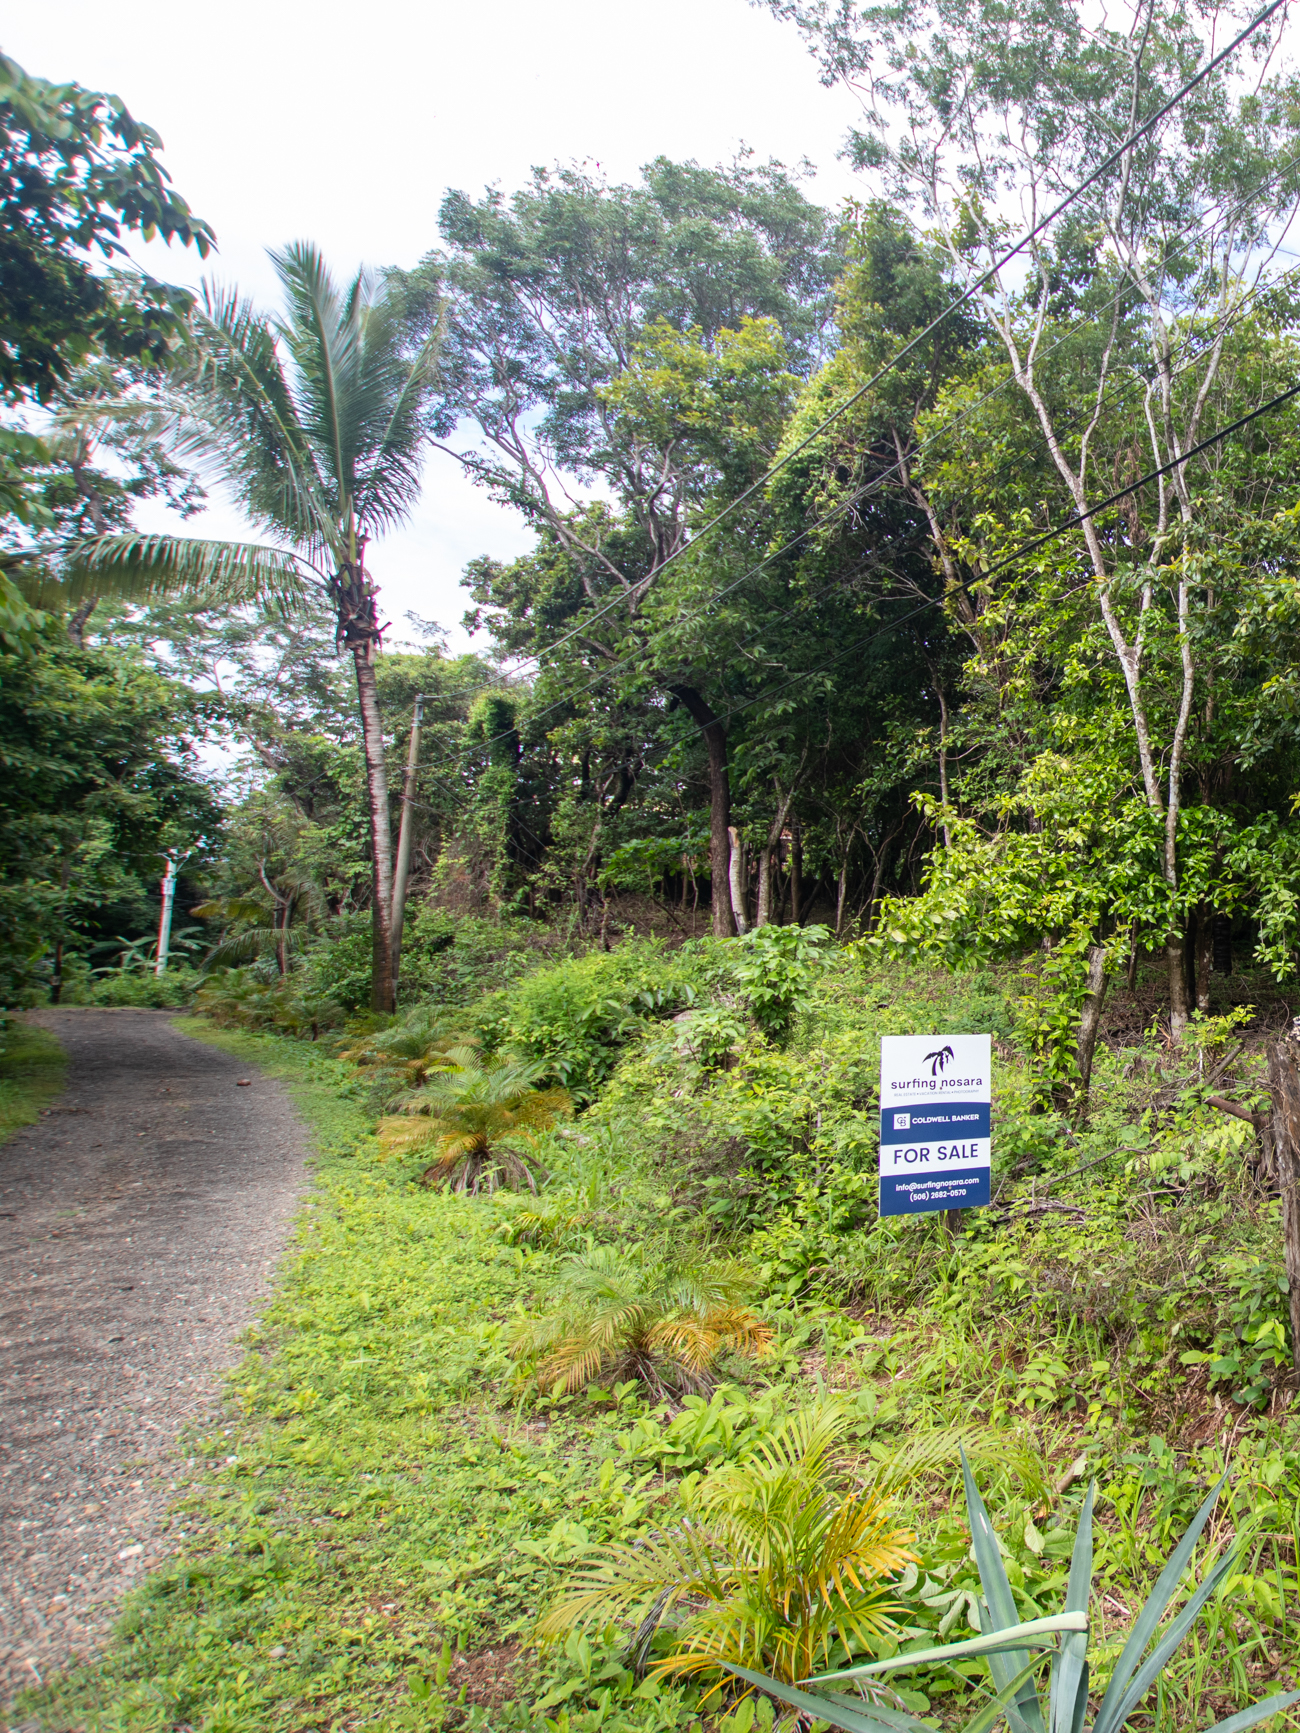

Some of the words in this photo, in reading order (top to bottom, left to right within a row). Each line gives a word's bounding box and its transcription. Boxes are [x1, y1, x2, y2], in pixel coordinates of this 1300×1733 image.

[891, 1078, 936, 1090] surfing
[941, 1078, 982, 1087] nosara
[912, 1116, 950, 1124] COLDWELL
[894, 1148, 930, 1164] FOR
[937, 1143, 978, 1161] SALE
[896, 1178, 979, 1191] info@surfingnosara.com
[931, 1189, 966, 1199] 2682-0570
